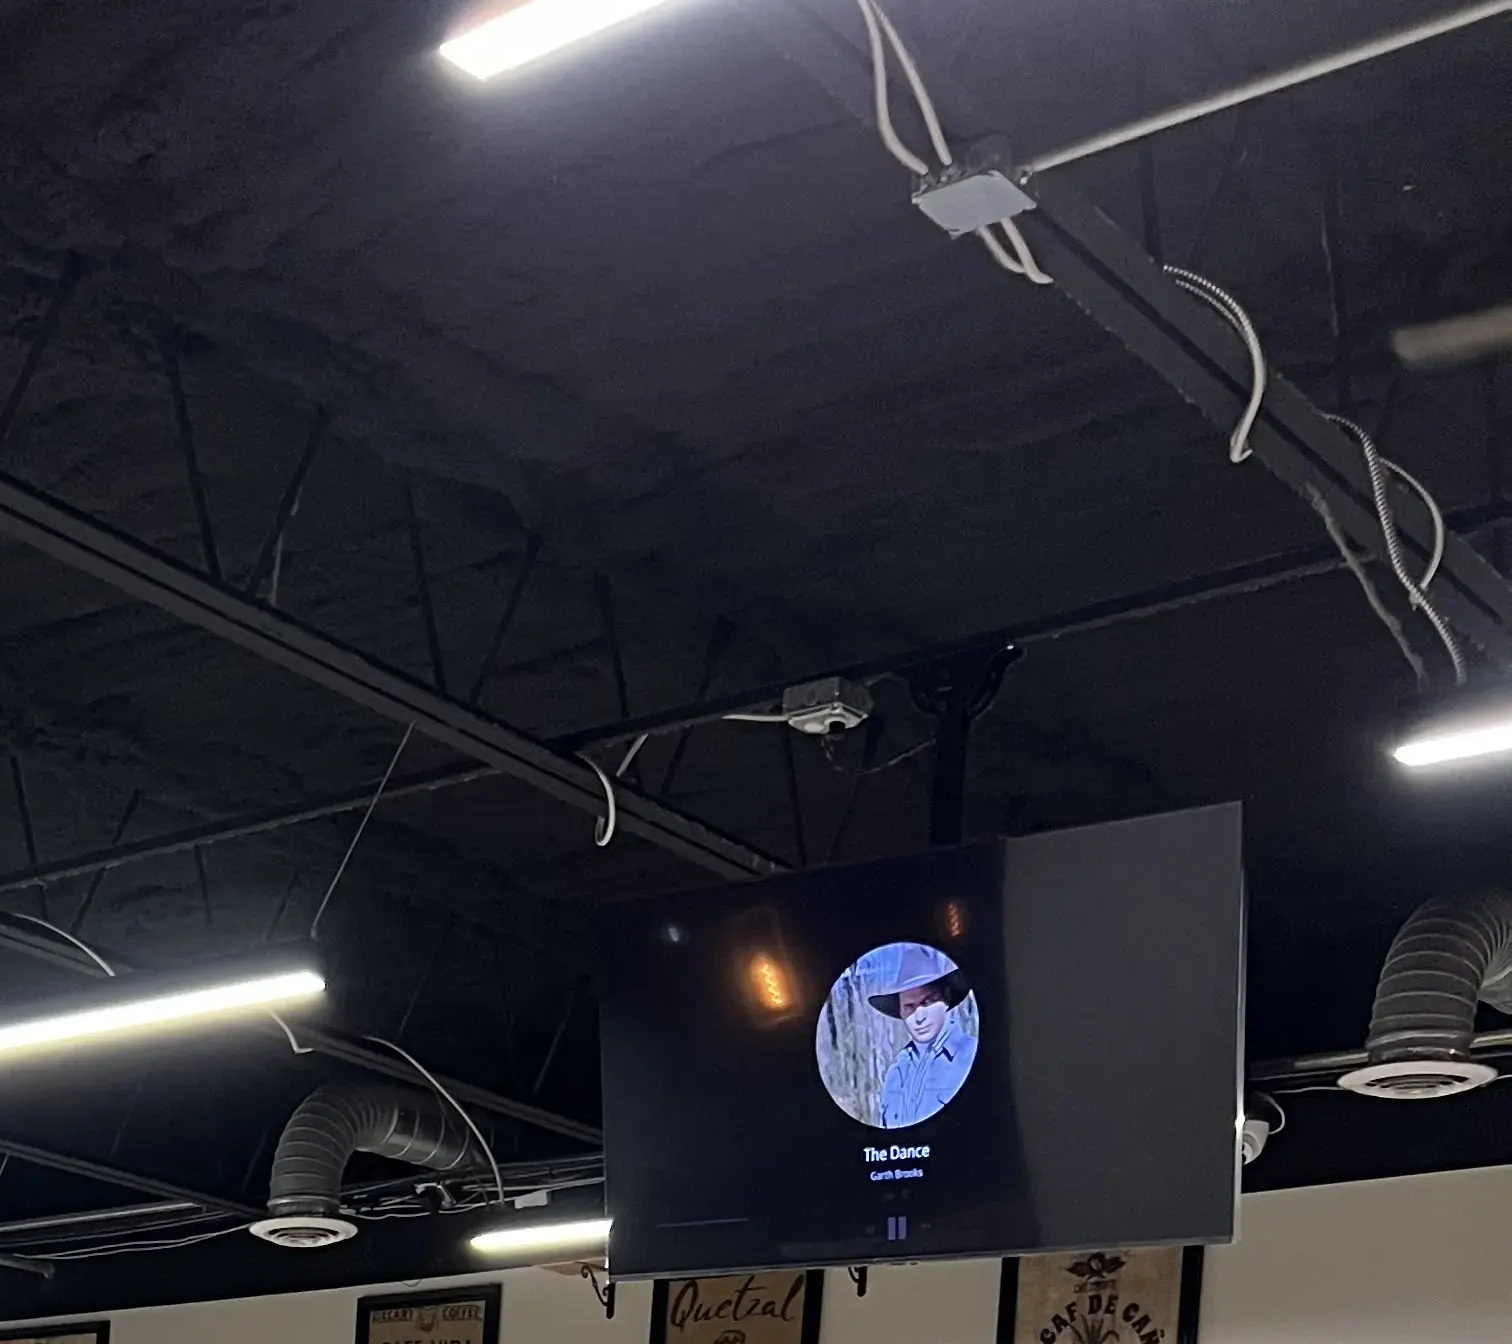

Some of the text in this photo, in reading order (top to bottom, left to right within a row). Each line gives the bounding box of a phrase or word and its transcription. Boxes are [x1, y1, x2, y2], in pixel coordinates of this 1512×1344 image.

[863, 1144, 931, 1162] The Dance
[870, 1170, 894, 1181] Garth
[670, 1273, 805, 1333] Quetzal
[1087, 1294, 1120, 1315] DE
